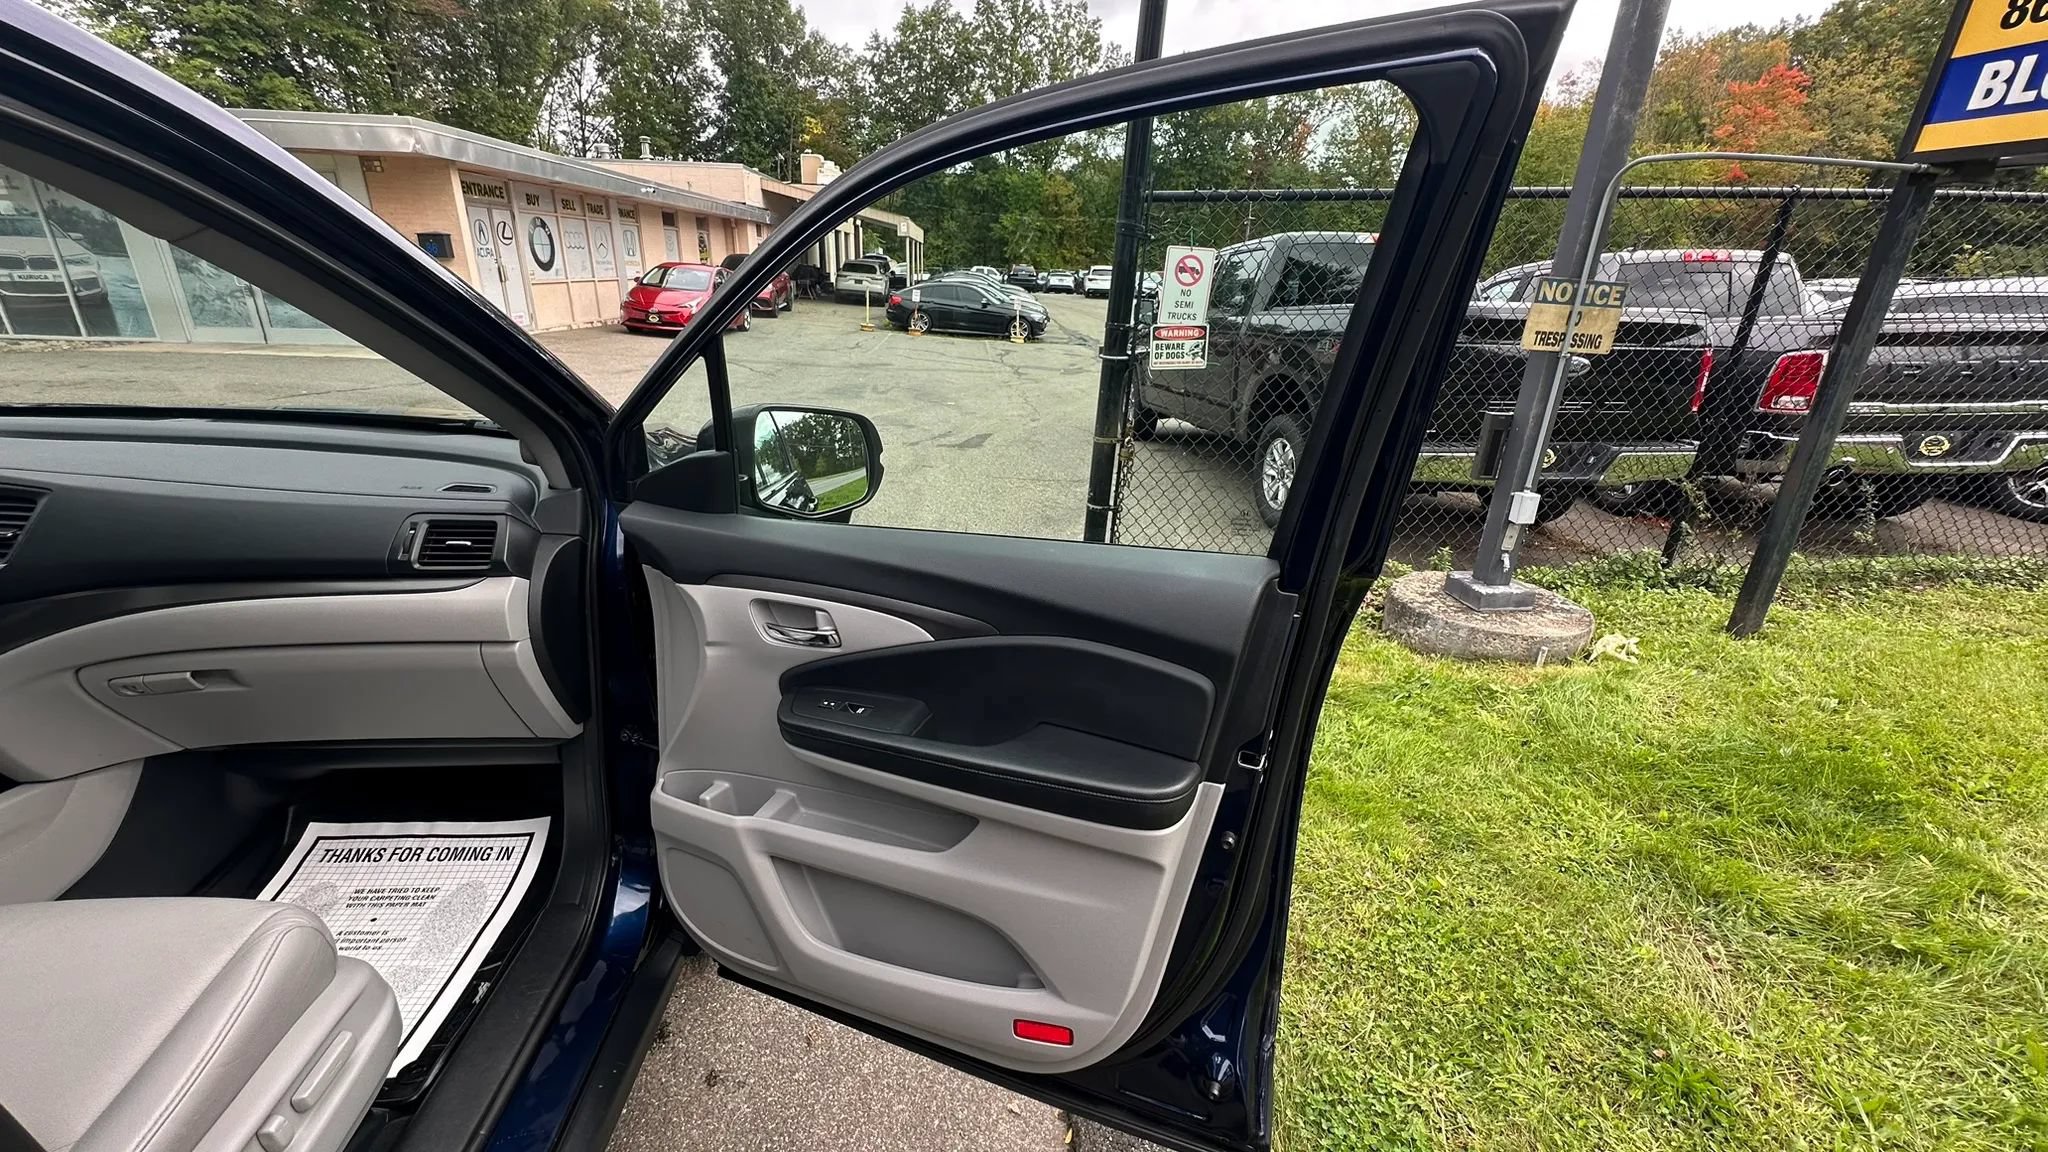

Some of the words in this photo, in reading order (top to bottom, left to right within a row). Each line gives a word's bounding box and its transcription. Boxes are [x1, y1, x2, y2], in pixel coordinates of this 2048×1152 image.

[460, 180, 504, 199] ENTRANCE
[525, 192, 540, 207] BUY
[561, 199, 576, 212] SELL
[586, 203, 604, 216] TRADE
[1180, 289, 1192, 297] NO
[1538, 280, 1626, 306] NOICE
[1174, 300, 1194, 309] SEMI
[1167, 312, 1197, 321] TRUCKS
[1160, 329, 1200, 337] WARNING
[1155, 342, 1185, 351] BEWARE
[1533, 330, 1603, 350] TRESPSSING
[1154, 351, 1164, 360] OF
[1166, 351, 1185, 360] DOGS
[319, 847, 387, 863] THANKS
[387, 846, 424, 863] FOR
[426, 846, 493, 862] COMING
[495, 845, 516, 862] IN
